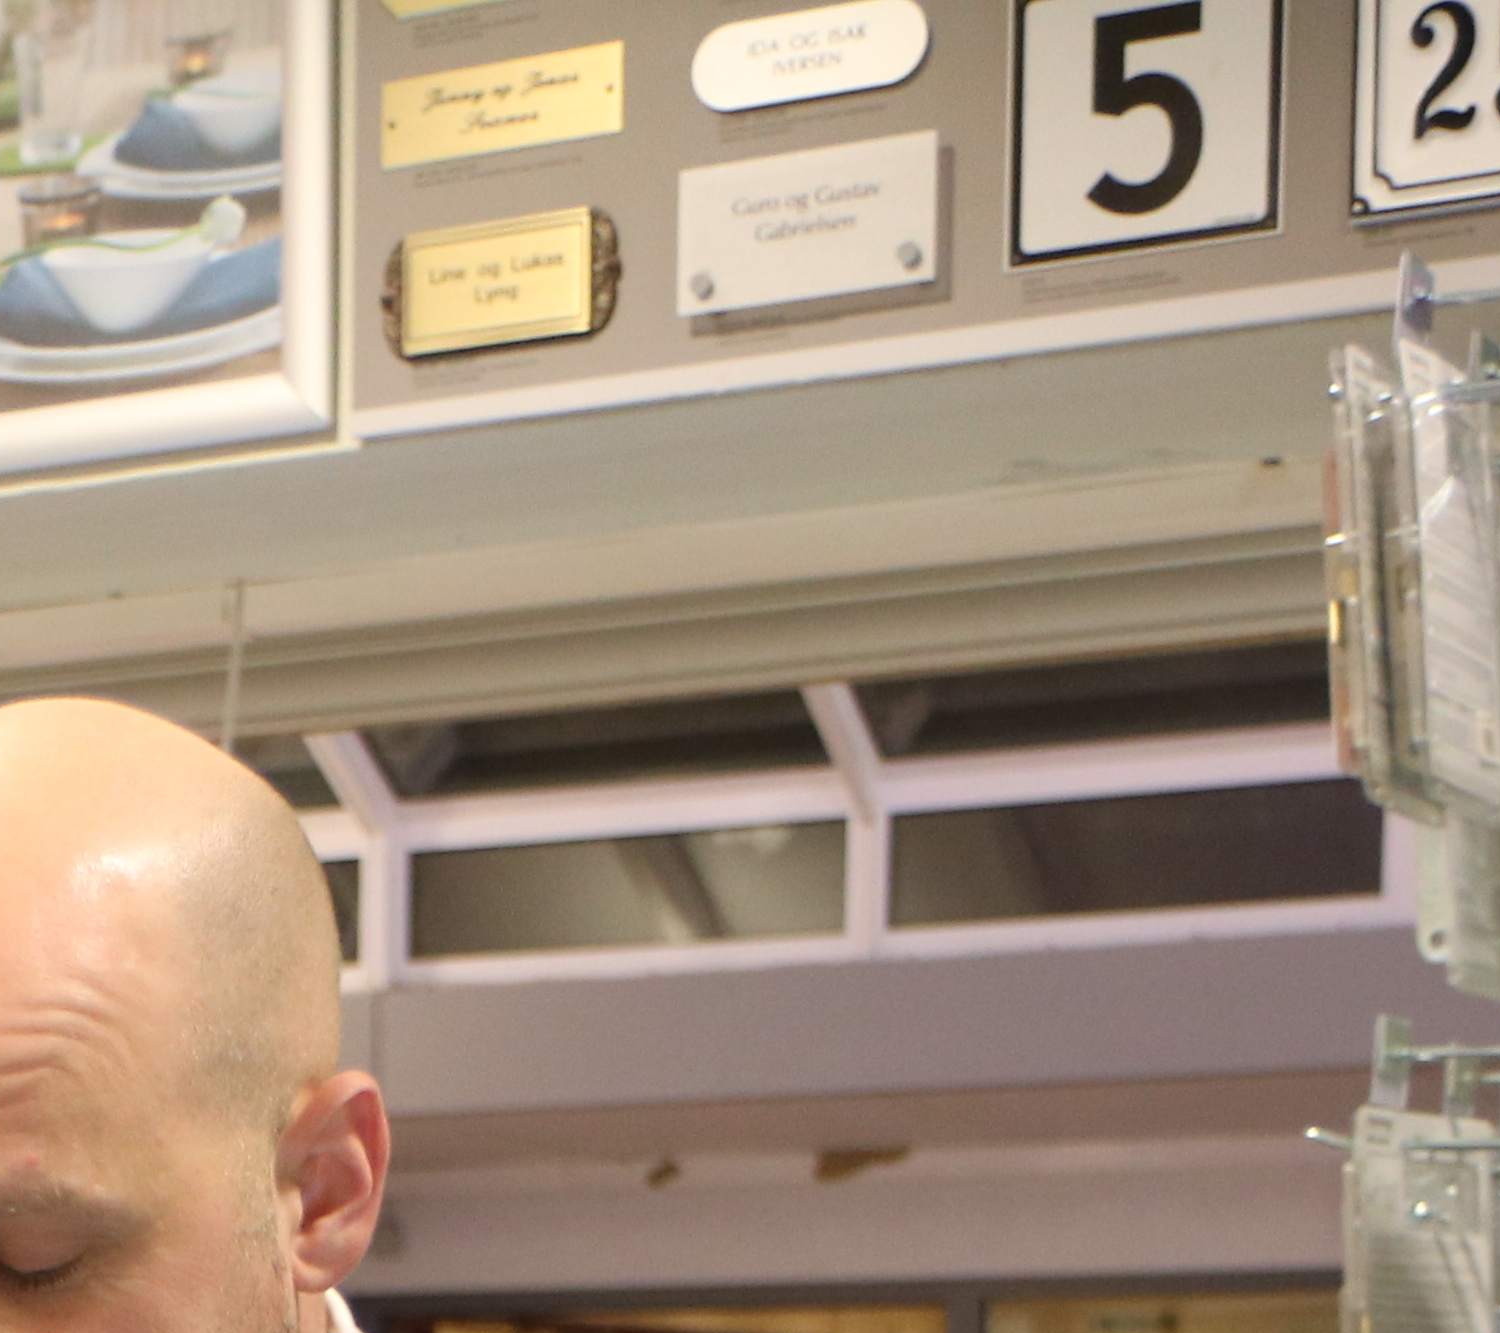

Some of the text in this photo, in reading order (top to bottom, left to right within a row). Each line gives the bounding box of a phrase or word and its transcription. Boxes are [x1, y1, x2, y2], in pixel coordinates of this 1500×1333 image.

[748, 41, 779, 57] IDA
[790, 30, 819, 48] OG
[1087, 0, 1204, 217] 5
